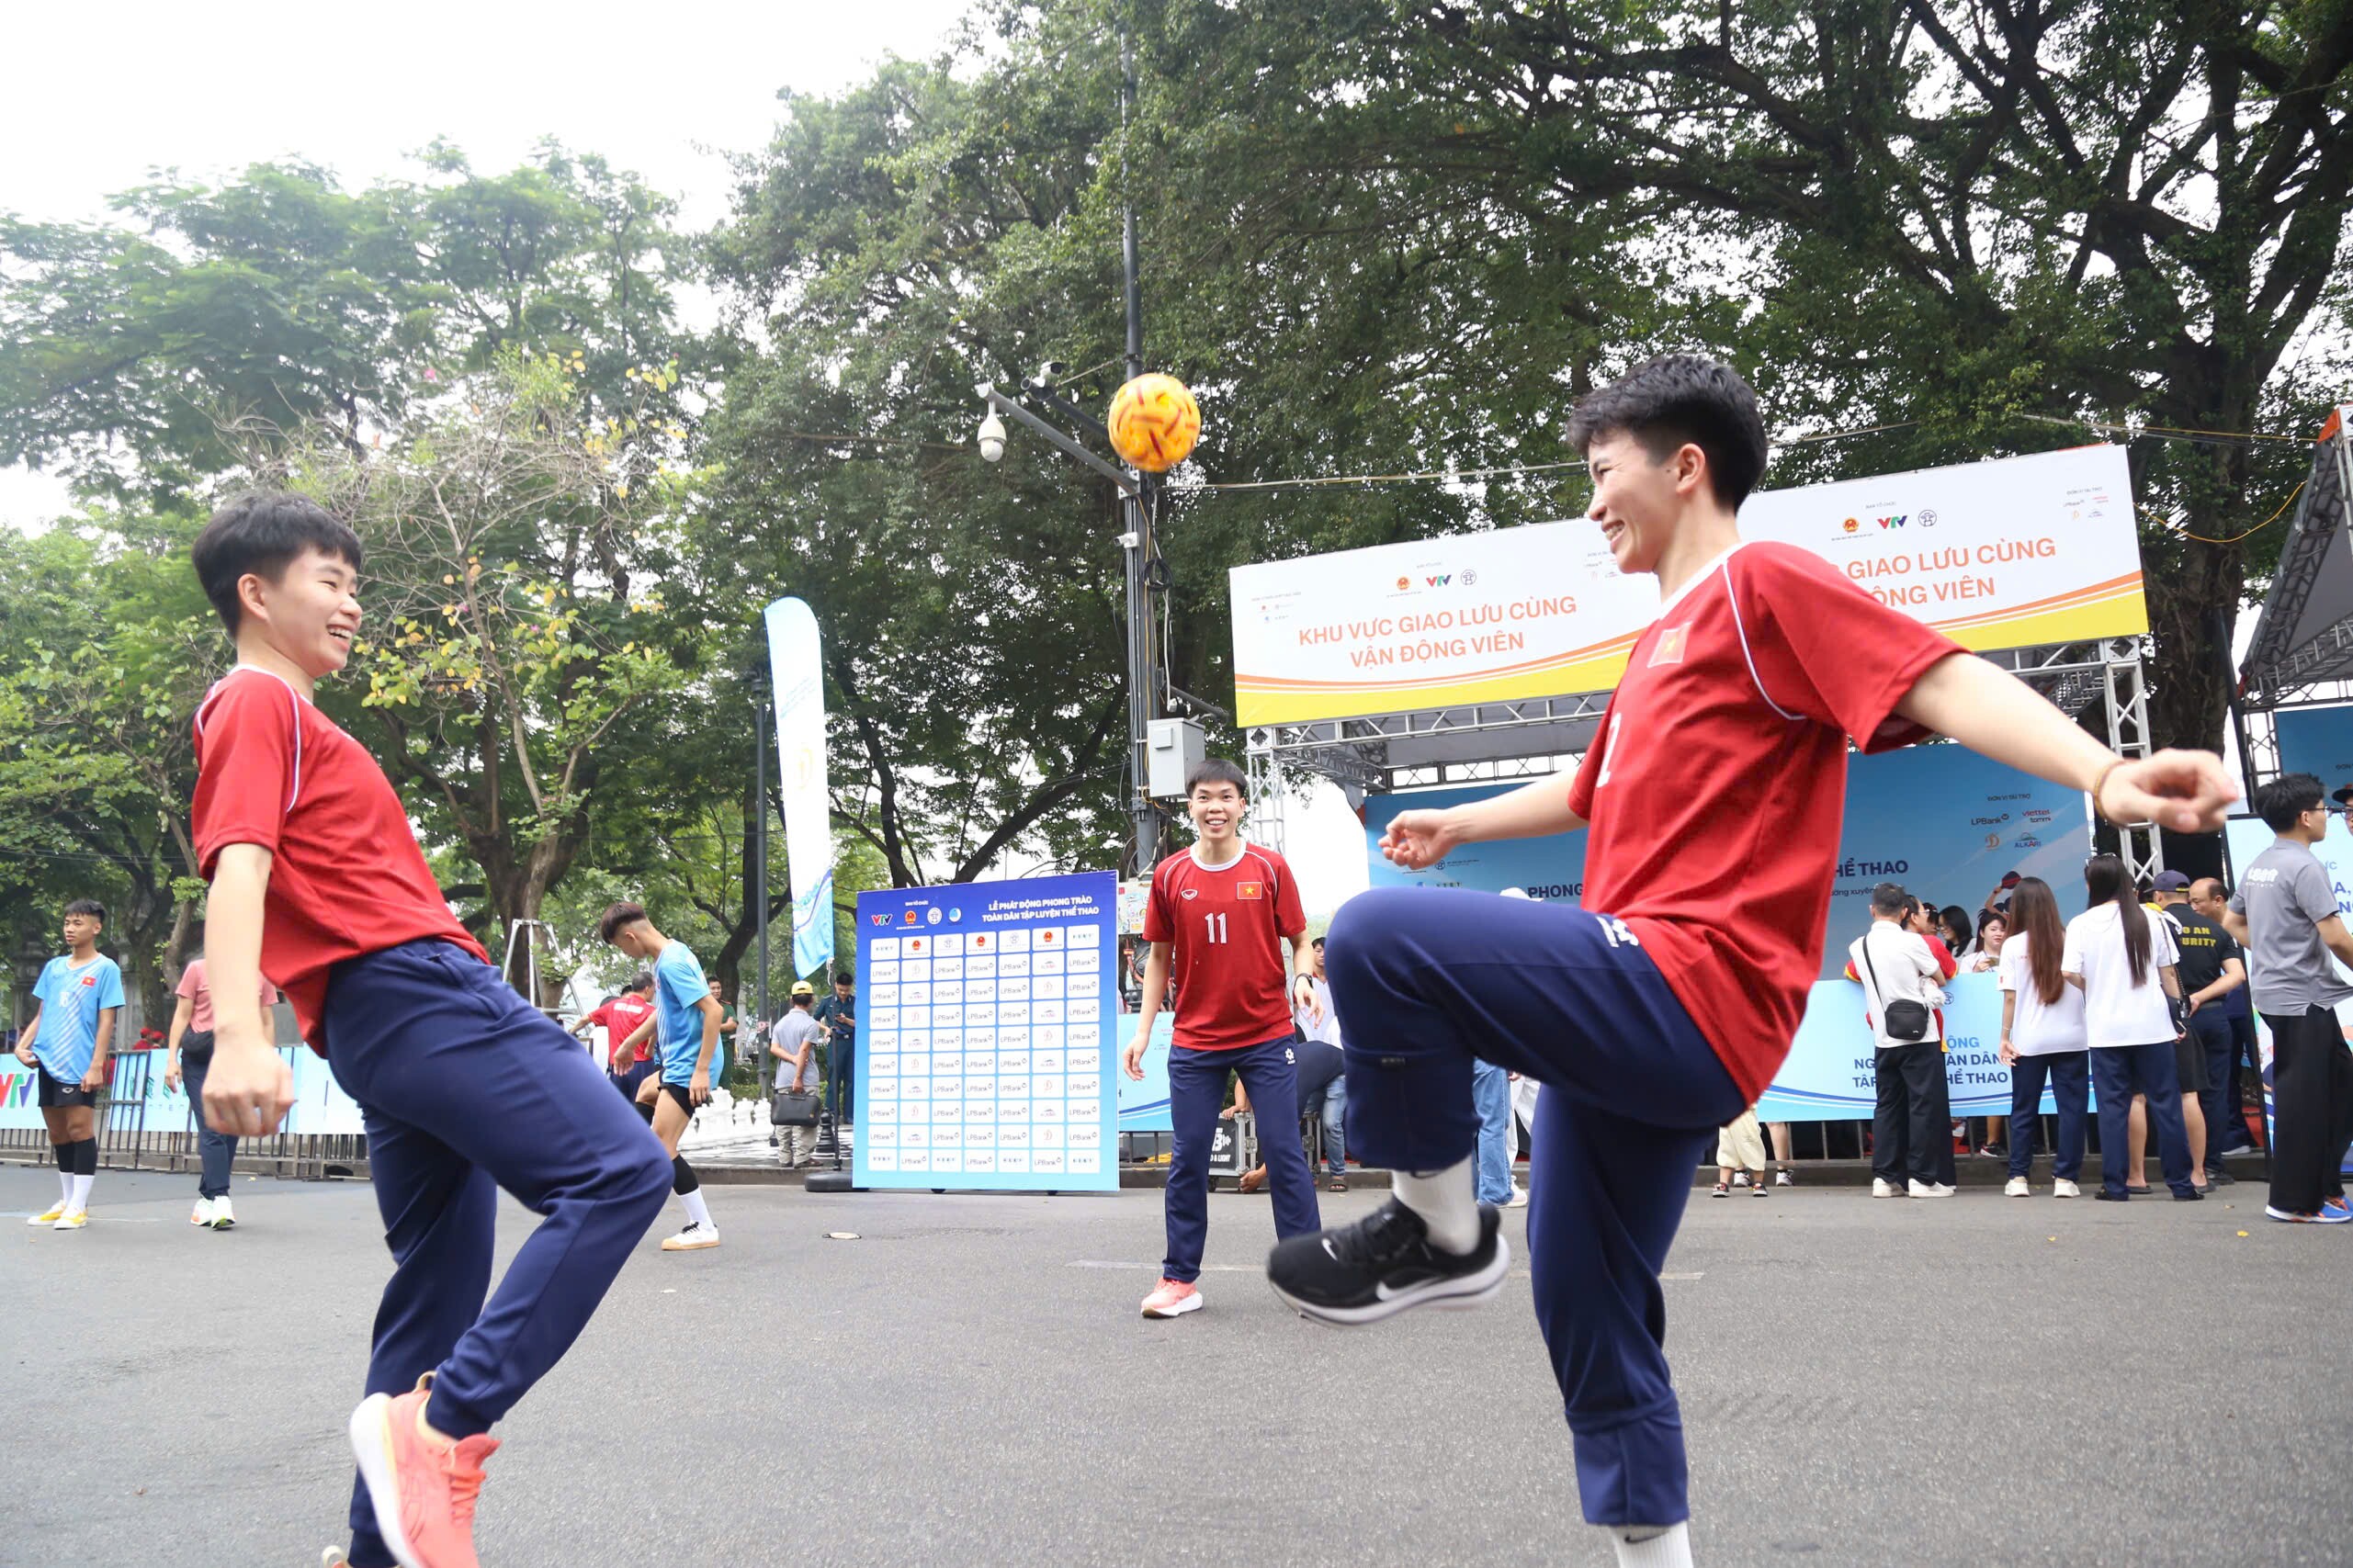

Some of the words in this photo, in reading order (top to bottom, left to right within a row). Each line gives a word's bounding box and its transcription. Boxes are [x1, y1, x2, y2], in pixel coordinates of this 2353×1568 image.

[1877, 515, 1907, 529] VTV
[1847, 555, 1912, 581] GIAO
[1918, 547, 1970, 572] LƯU
[1976, 538, 2056, 565] CÙNG
[1426, 574, 1452, 588] VTV
[1933, 576, 1996, 602] VIÊN
[1298, 625, 1343, 646] KHU
[1348, 617, 1393, 641] VỰC
[1398, 611, 1454, 634] GIAO
[1459, 604, 1503, 626] LƯU
[1510, 595, 1577, 620] CÙNG
[1351, 645, 1394, 670] VẬN
[1399, 638, 1466, 664] ĐỘNG
[1471, 630, 1524, 654] VIÊN
[1971, 818, 2001, 826] LPBank
[1836, 857, 1856, 877] HỂ
[1858, 860, 1908, 876] THAO
[1527, 883, 1584, 898] PHONG
[999, 899, 1019, 910] PHÁT
[1042, 897, 1070, 908] PHONG
[1070, 895, 1092, 905] TRÀO
[871, 913, 893, 927] VTV
[982, 911, 1004, 922] TOÀN
[1077, 906, 1100, 916] THAO
[1204, 912, 1227, 944] 11
[2193, 927, 2211, 935] AN
[2182, 937, 2217, 947] URITY
[1946, 1036, 1980, 1050] ỘNG
[1854, 1057, 1875, 1069] NG
[1946, 1054, 1967, 1066] ÀN
[1971, 1050, 1999, 1065] DÂN
[1947, 1068, 1963, 1085] HỂ
[1965, 1071, 2008, 1085] THAO
